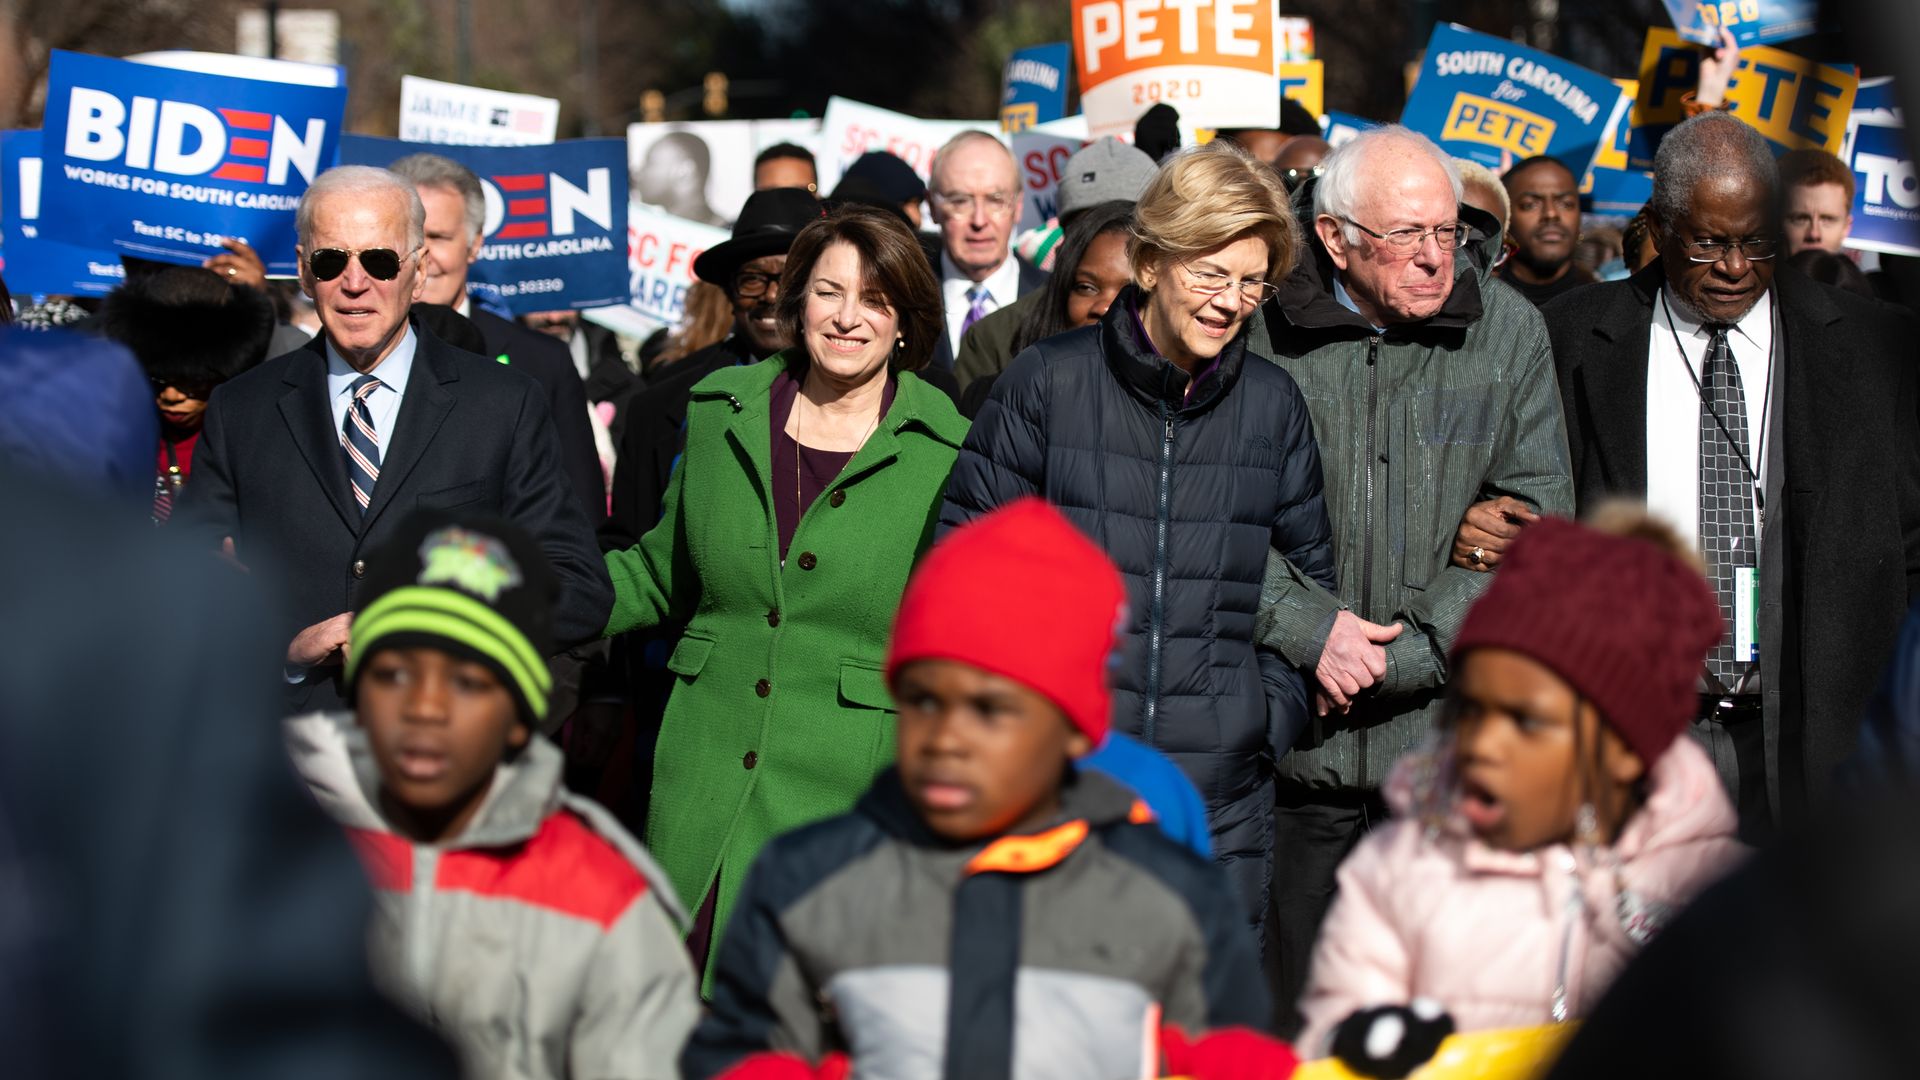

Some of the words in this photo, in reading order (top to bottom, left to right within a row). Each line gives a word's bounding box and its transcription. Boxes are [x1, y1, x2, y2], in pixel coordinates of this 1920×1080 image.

[1082, 0, 1261, 74] PETE
[1132, 80, 1201, 105] 2020
[1436, 51, 1505, 77] SOUTH
[1507, 57, 1600, 125] CAROLINA
[1491, 79, 1527, 102] for
[64, 86, 326, 187] BIDEN
[1453, 103, 1544, 152] PETE
[64, 164, 130, 191] WORKS
[131, 176, 169, 198] FOR
[170, 183, 234, 207] SOUTH
[235, 191, 301, 211] CAROLIN
[132, 220, 163, 238] Text
[164, 226, 185, 242] SC
[186, 231, 202, 244] to
[522, 237, 613, 258] CAROLINA
[500, 284, 518, 297] to
[518, 278, 564, 295] 30330
